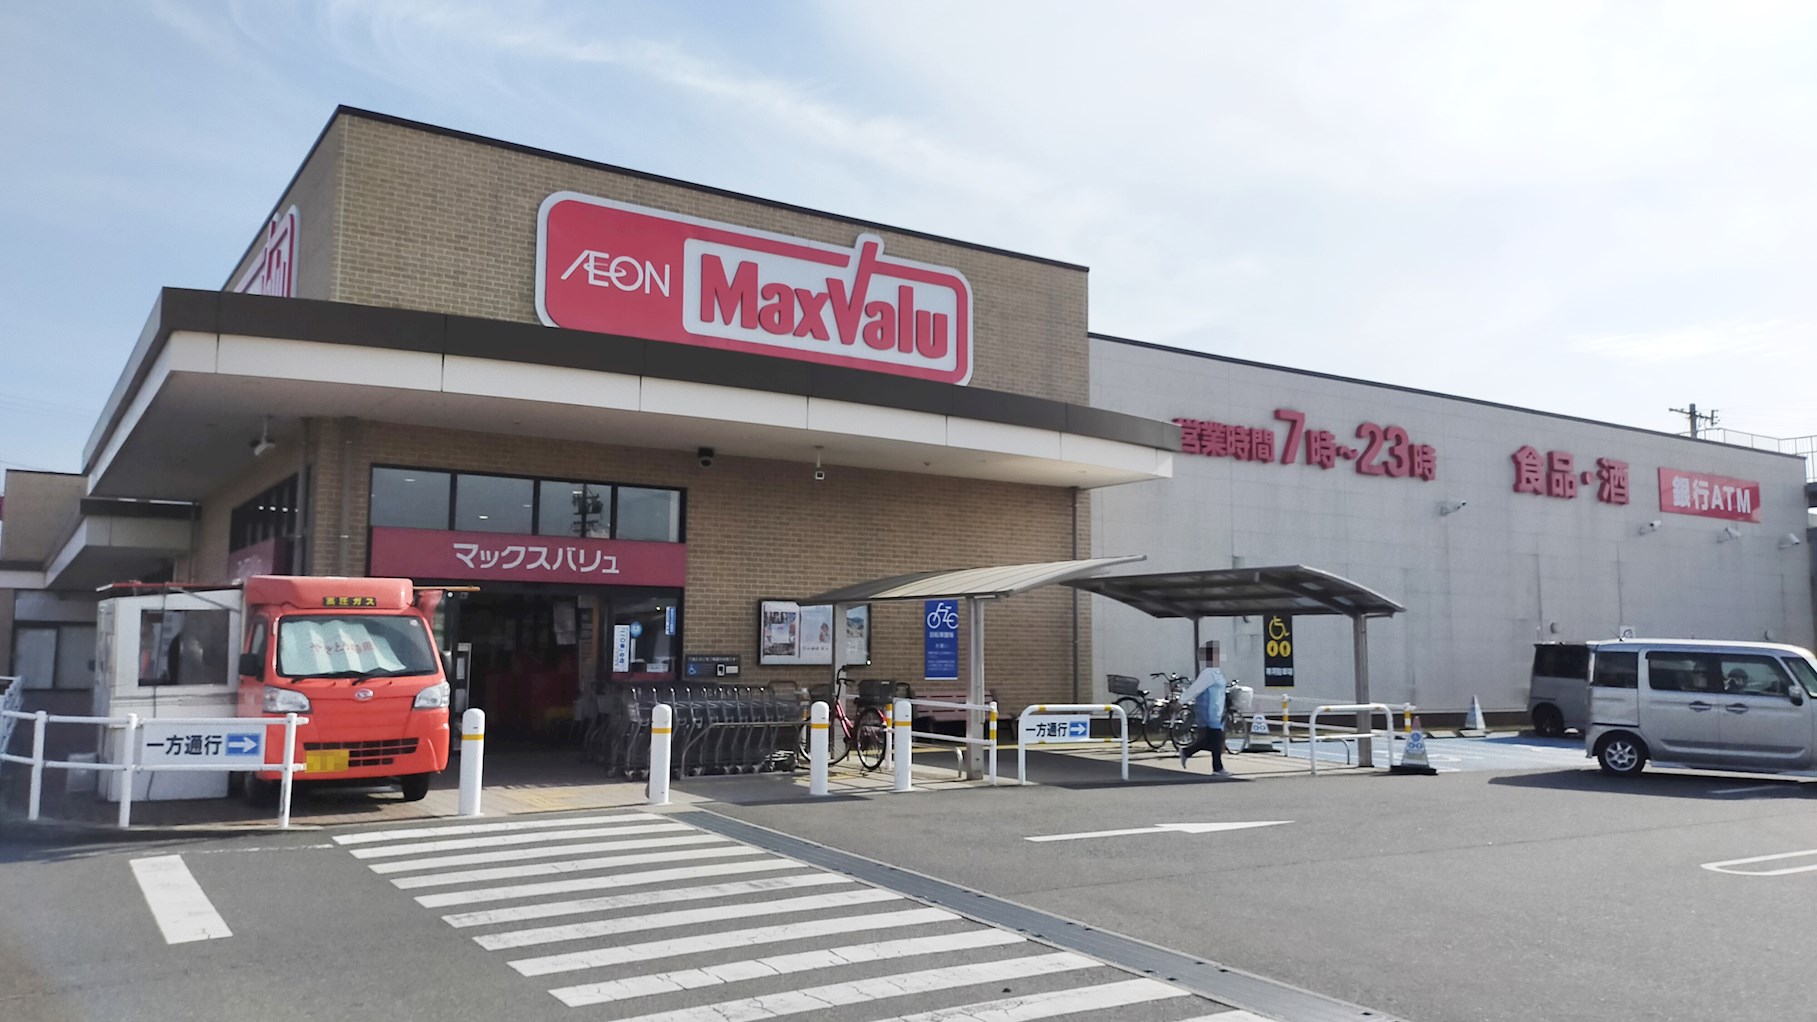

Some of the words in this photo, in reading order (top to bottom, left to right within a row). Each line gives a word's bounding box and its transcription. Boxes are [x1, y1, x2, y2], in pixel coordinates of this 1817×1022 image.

[700, 241, 948, 359] MaxValu
[1672, 475, 1751, 514] 銀行ATM
[453, 543, 620, 574] マックスバリュ
[146, 735, 222, 755] 一方通行
[1025, 722, 1067, 737] 一方通行
